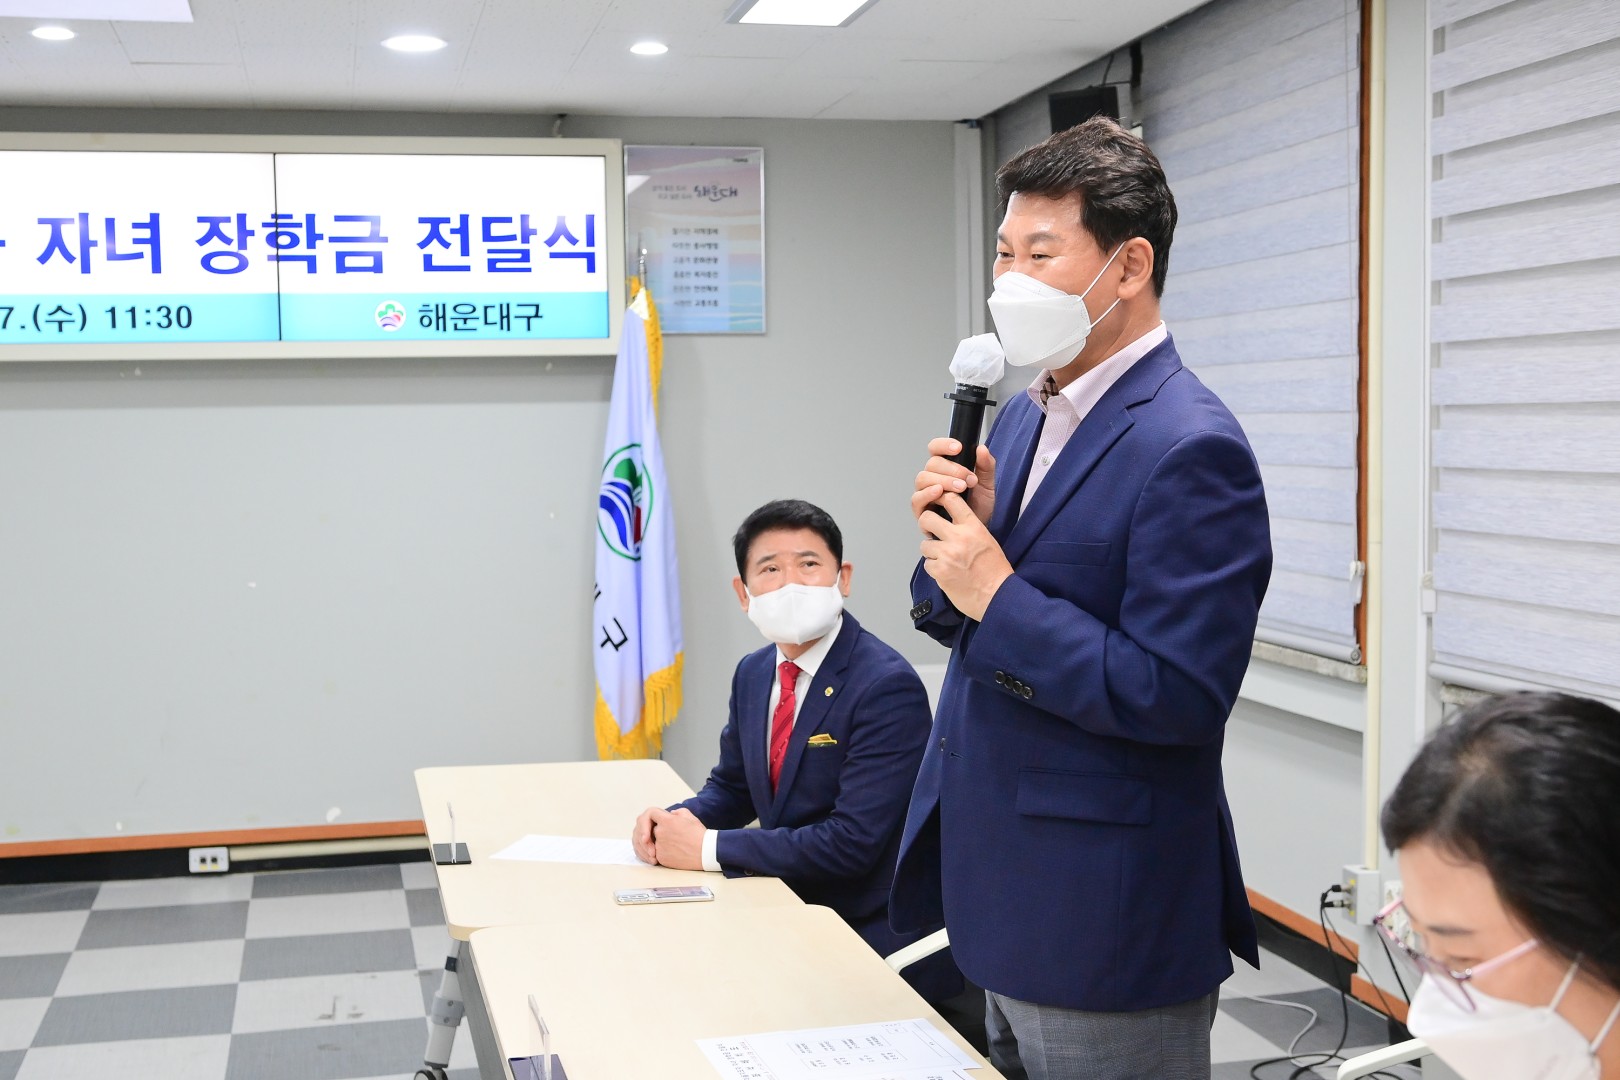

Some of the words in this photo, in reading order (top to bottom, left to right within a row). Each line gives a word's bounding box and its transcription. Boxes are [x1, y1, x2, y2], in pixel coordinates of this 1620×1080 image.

[36, 212, 162, 274] 자녀
[195, 212, 389, 275] 장학금
[416, 213, 598, 274] 전달식
[105, 305, 193, 330] 11:30
[418, 302, 543, 332] 해운대구
